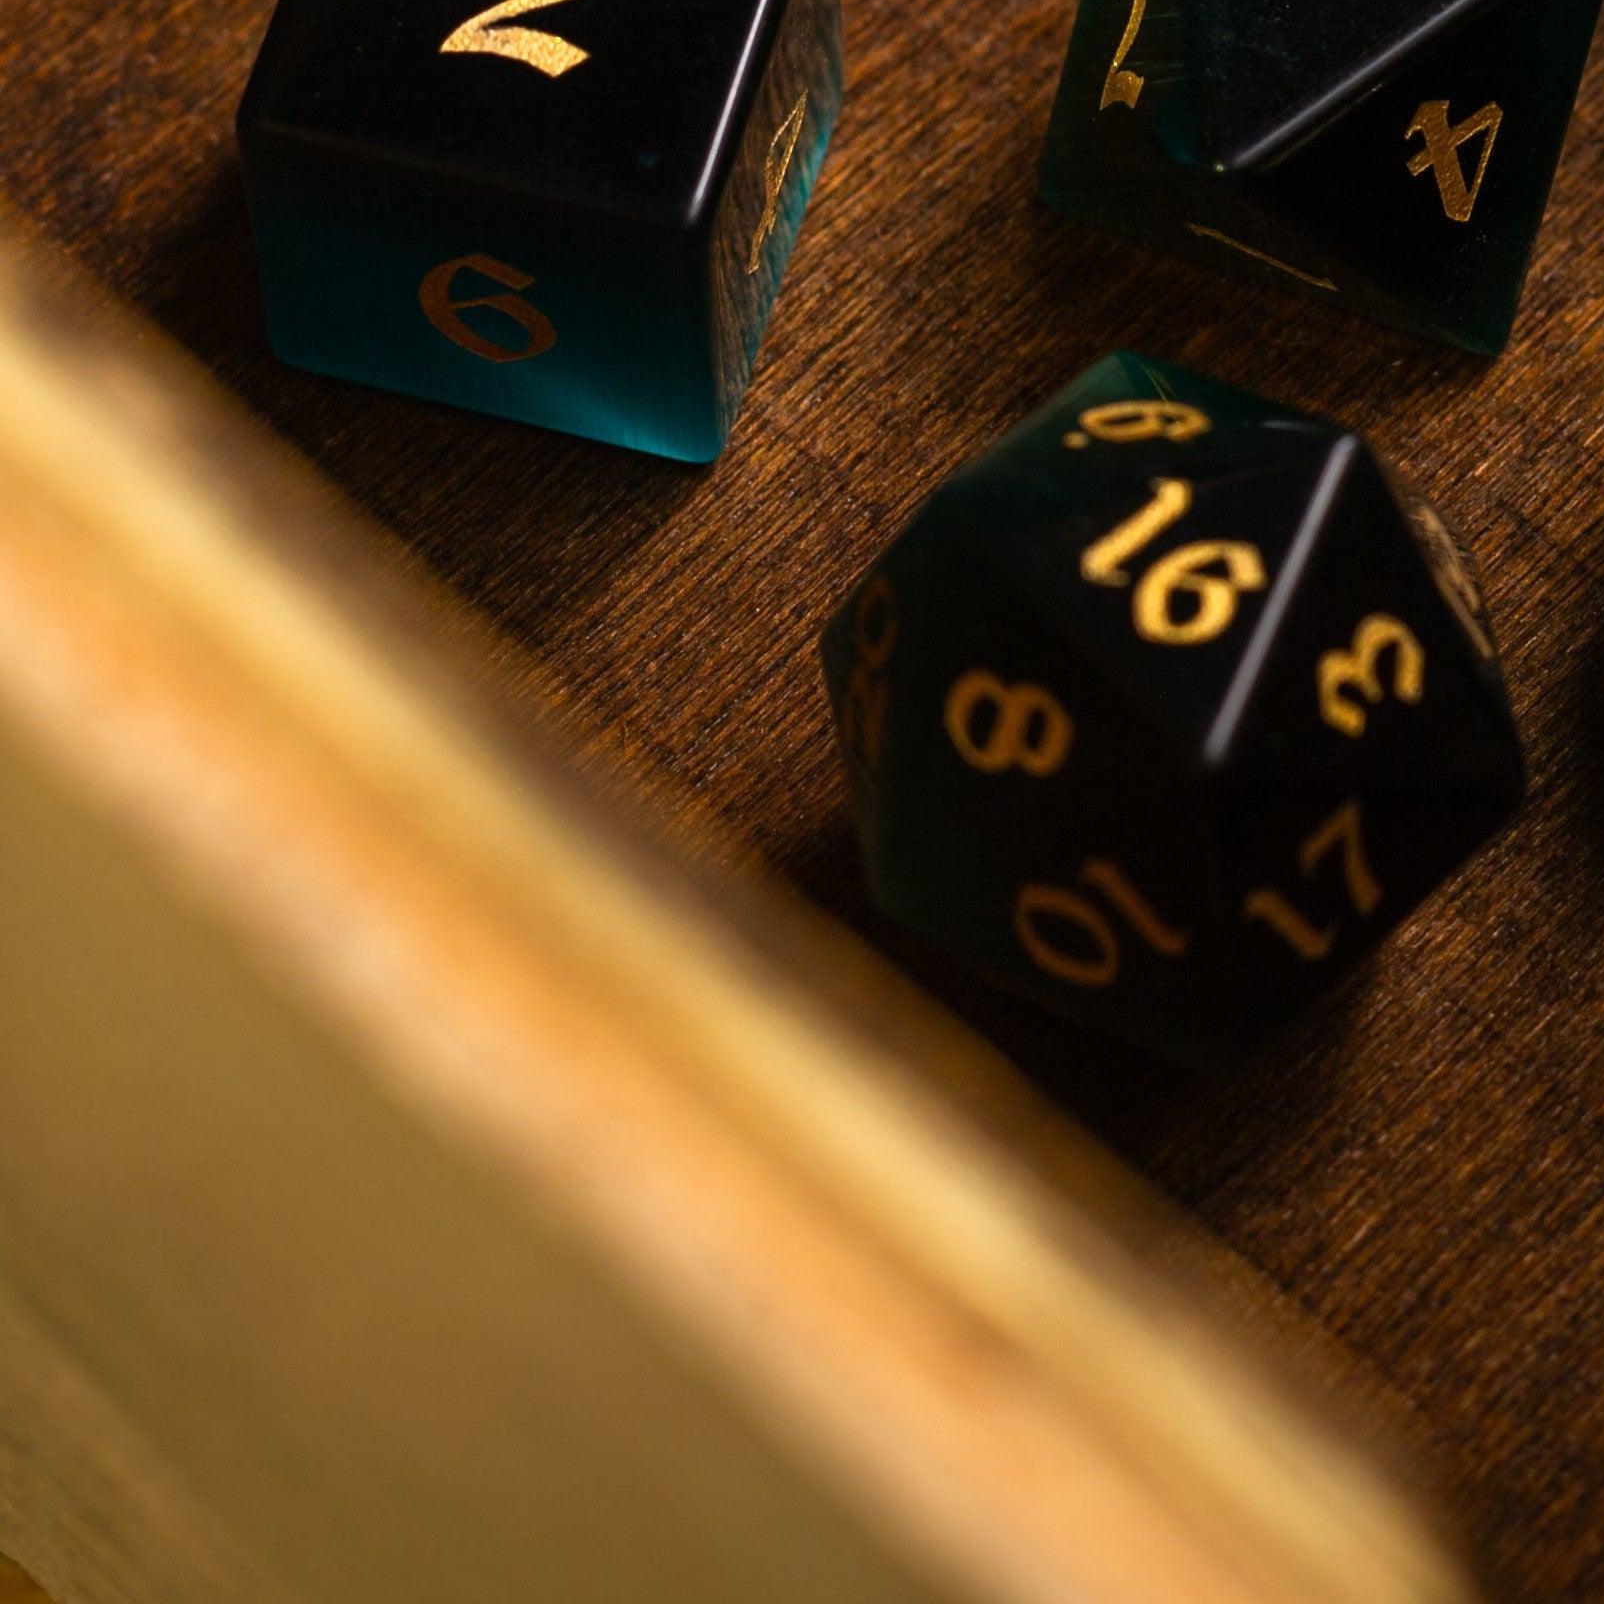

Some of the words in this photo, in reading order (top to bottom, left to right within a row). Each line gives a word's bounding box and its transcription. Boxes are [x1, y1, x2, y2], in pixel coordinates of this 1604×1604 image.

[1404, 98, 1504, 223] 4
[417, 252, 558, 364] 6
[1078, 475, 1270, 647] 16
[942, 668, 1074, 777] 8
[1316, 612, 1425, 740] 3
[1013, 859, 1189, 986] 10
[1241, 800, 1384, 962] 17
